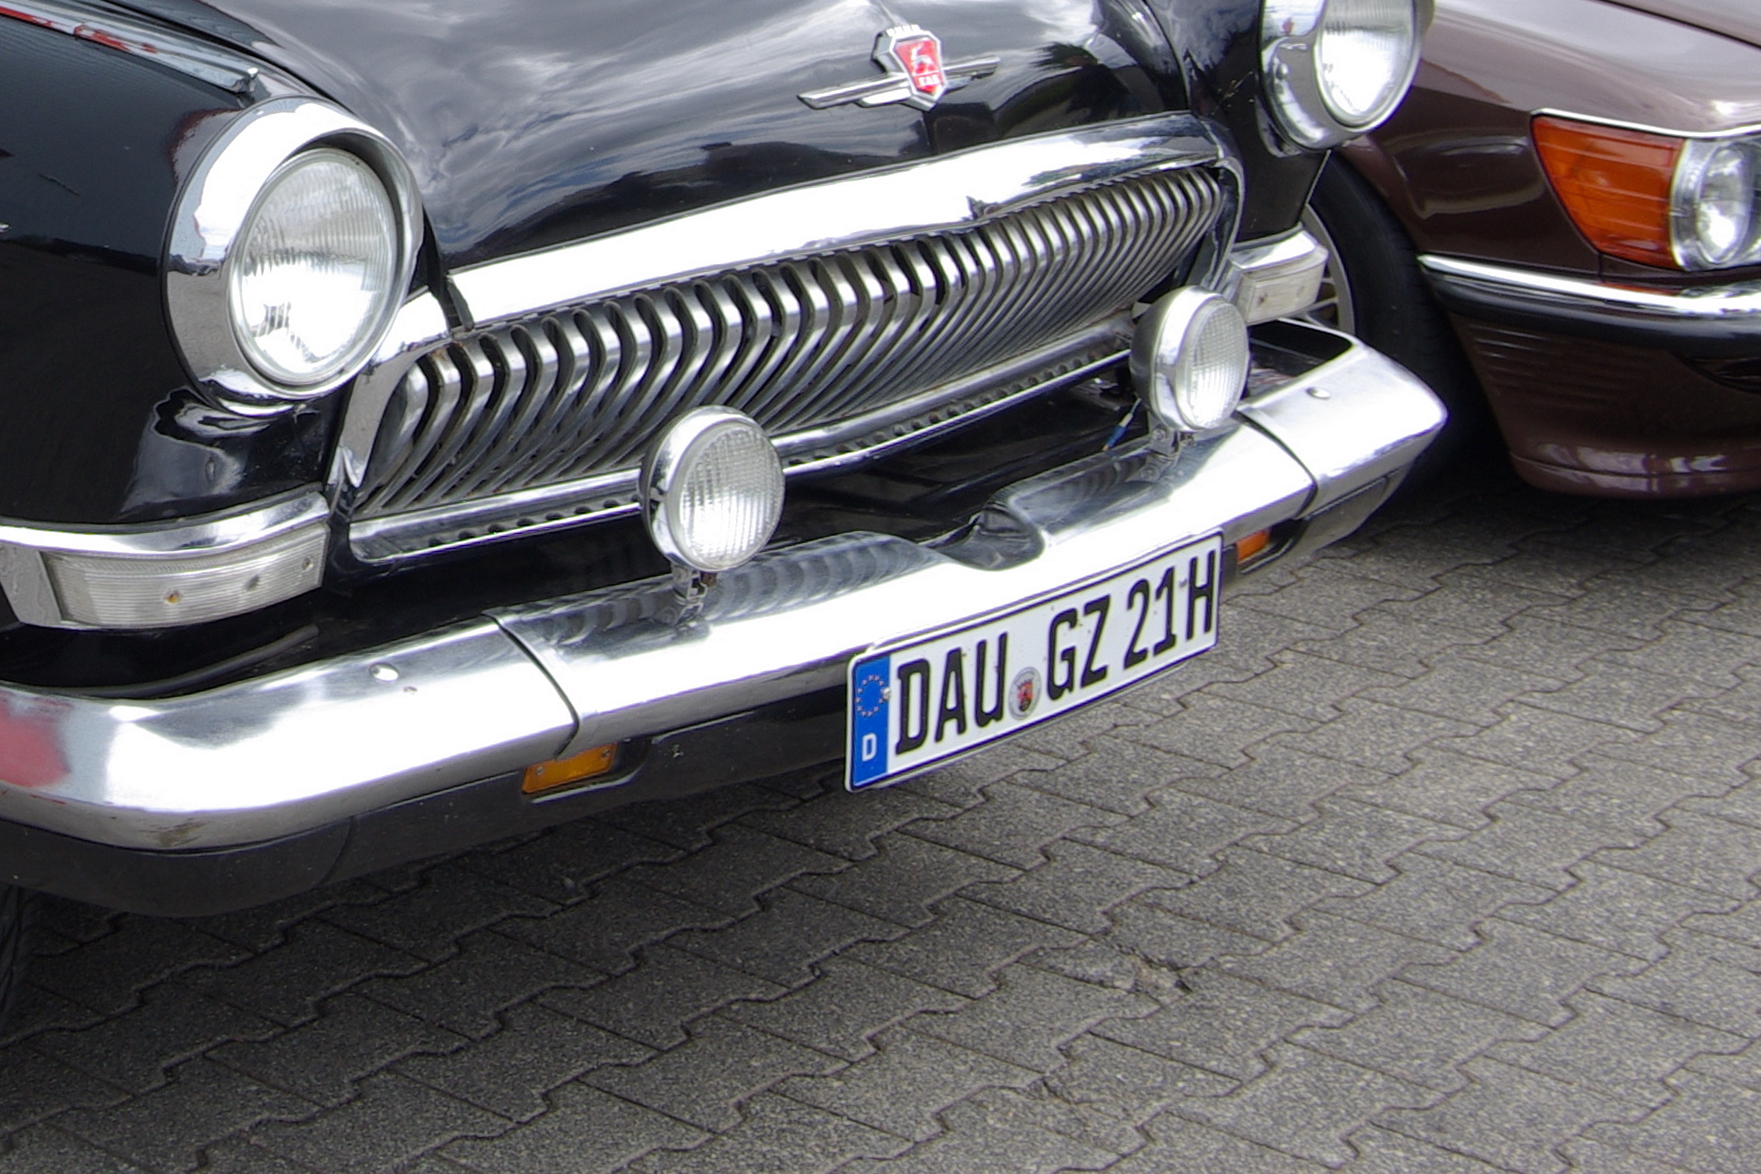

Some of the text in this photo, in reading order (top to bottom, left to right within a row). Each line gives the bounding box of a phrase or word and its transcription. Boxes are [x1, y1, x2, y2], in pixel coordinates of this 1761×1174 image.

[895, 631, 1008, 756] DAU
[1047, 593, 1112, 702] GZ
[1123, 549, 1217, 670] 21H
[862, 732, 877, 762] D
